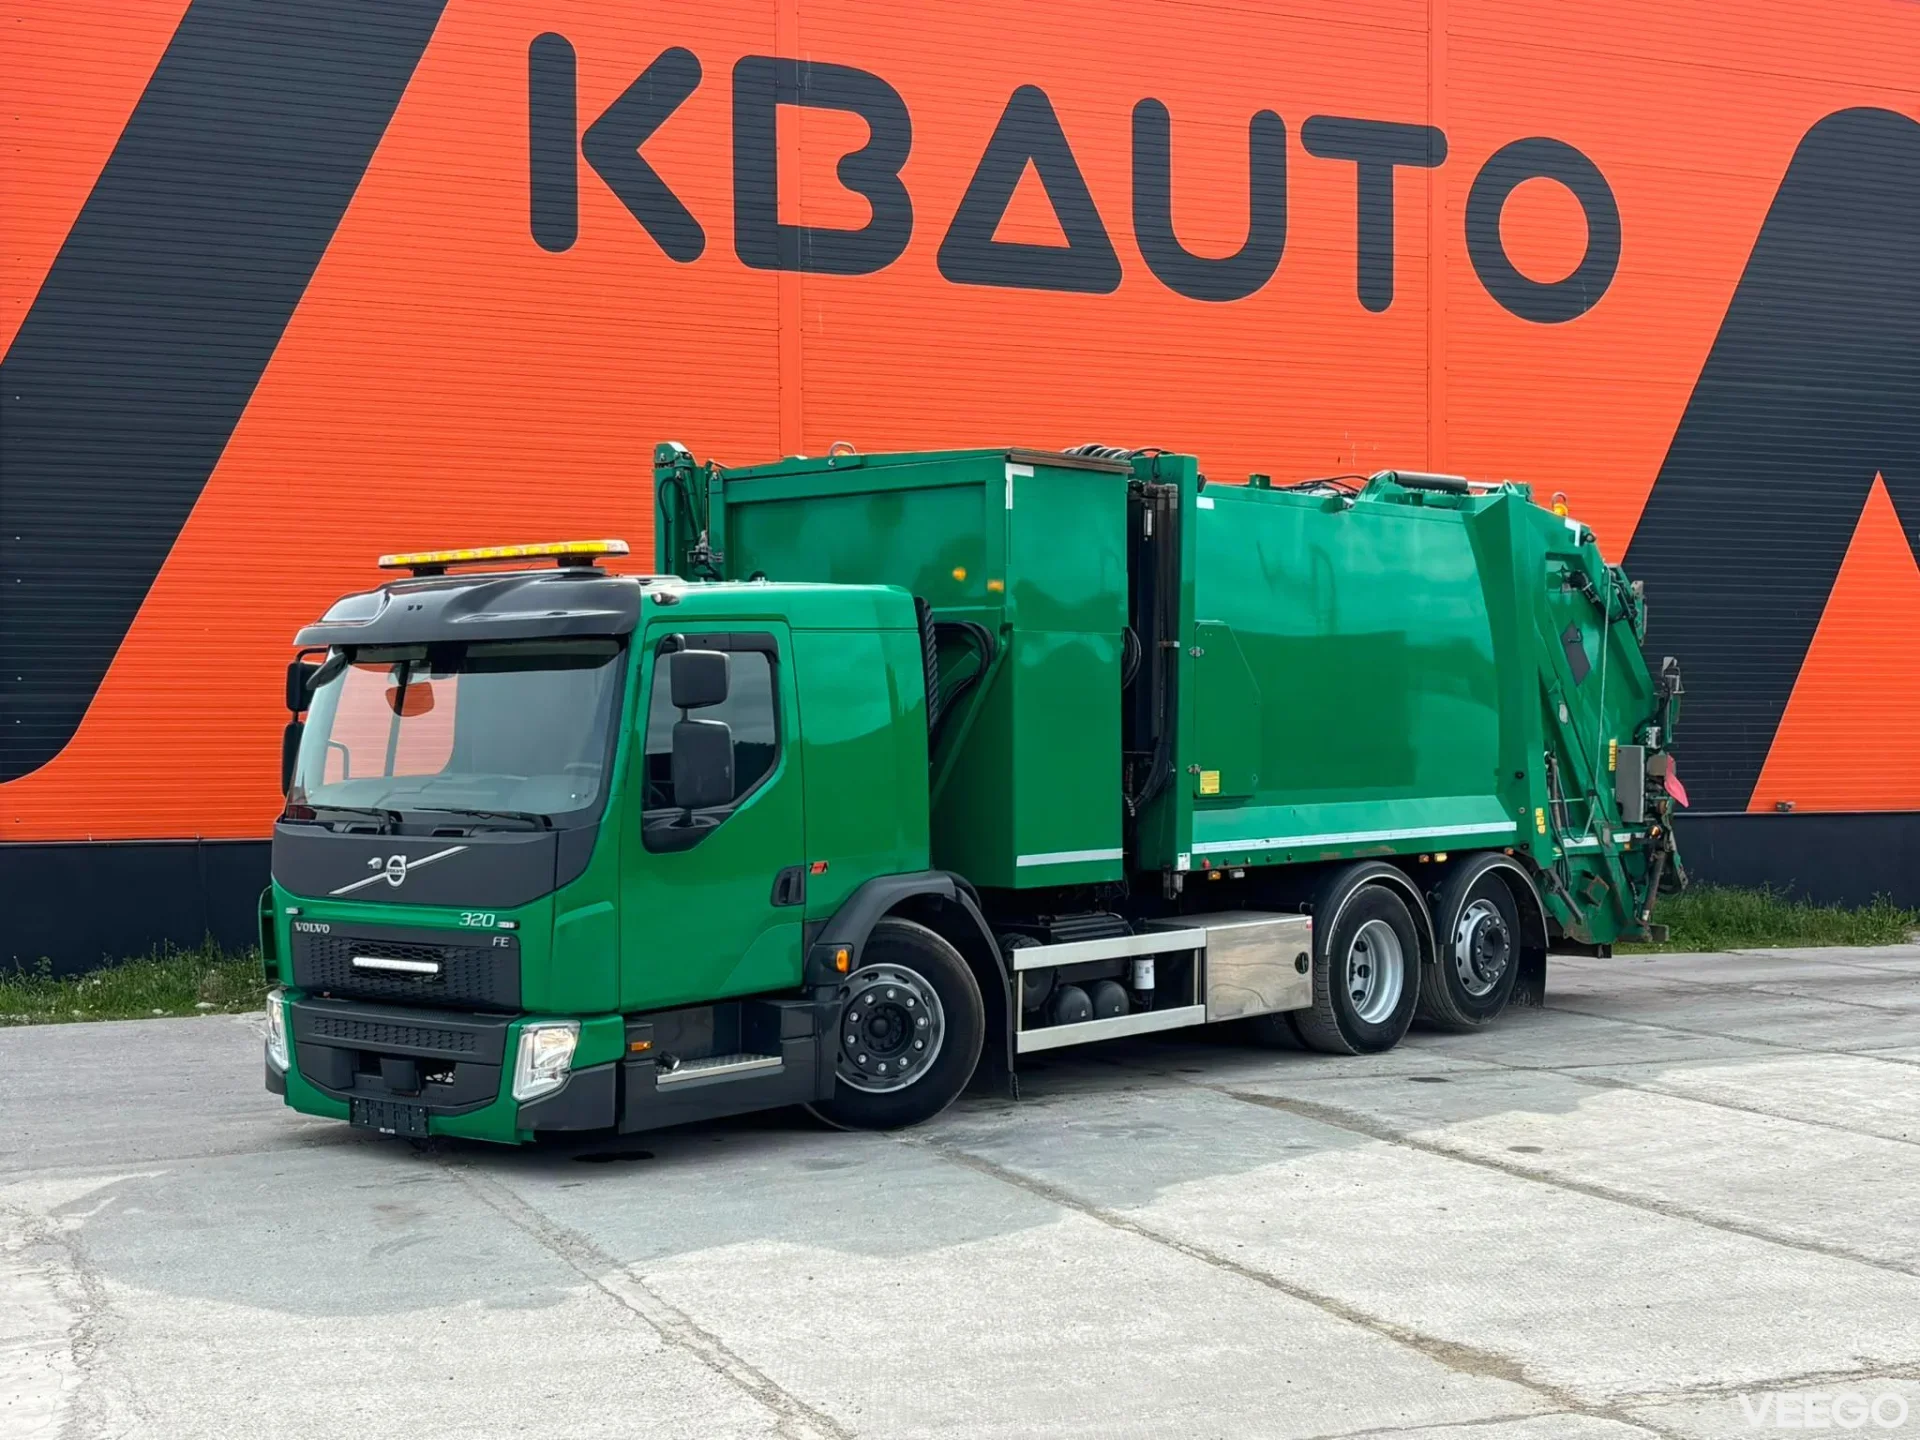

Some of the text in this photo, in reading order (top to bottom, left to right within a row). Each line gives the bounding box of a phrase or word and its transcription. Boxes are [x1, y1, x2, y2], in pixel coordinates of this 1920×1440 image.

[458, 912, 496, 927] 320
[294, 921, 331, 934] VOLVO
[492, 936, 510, 948] FE
